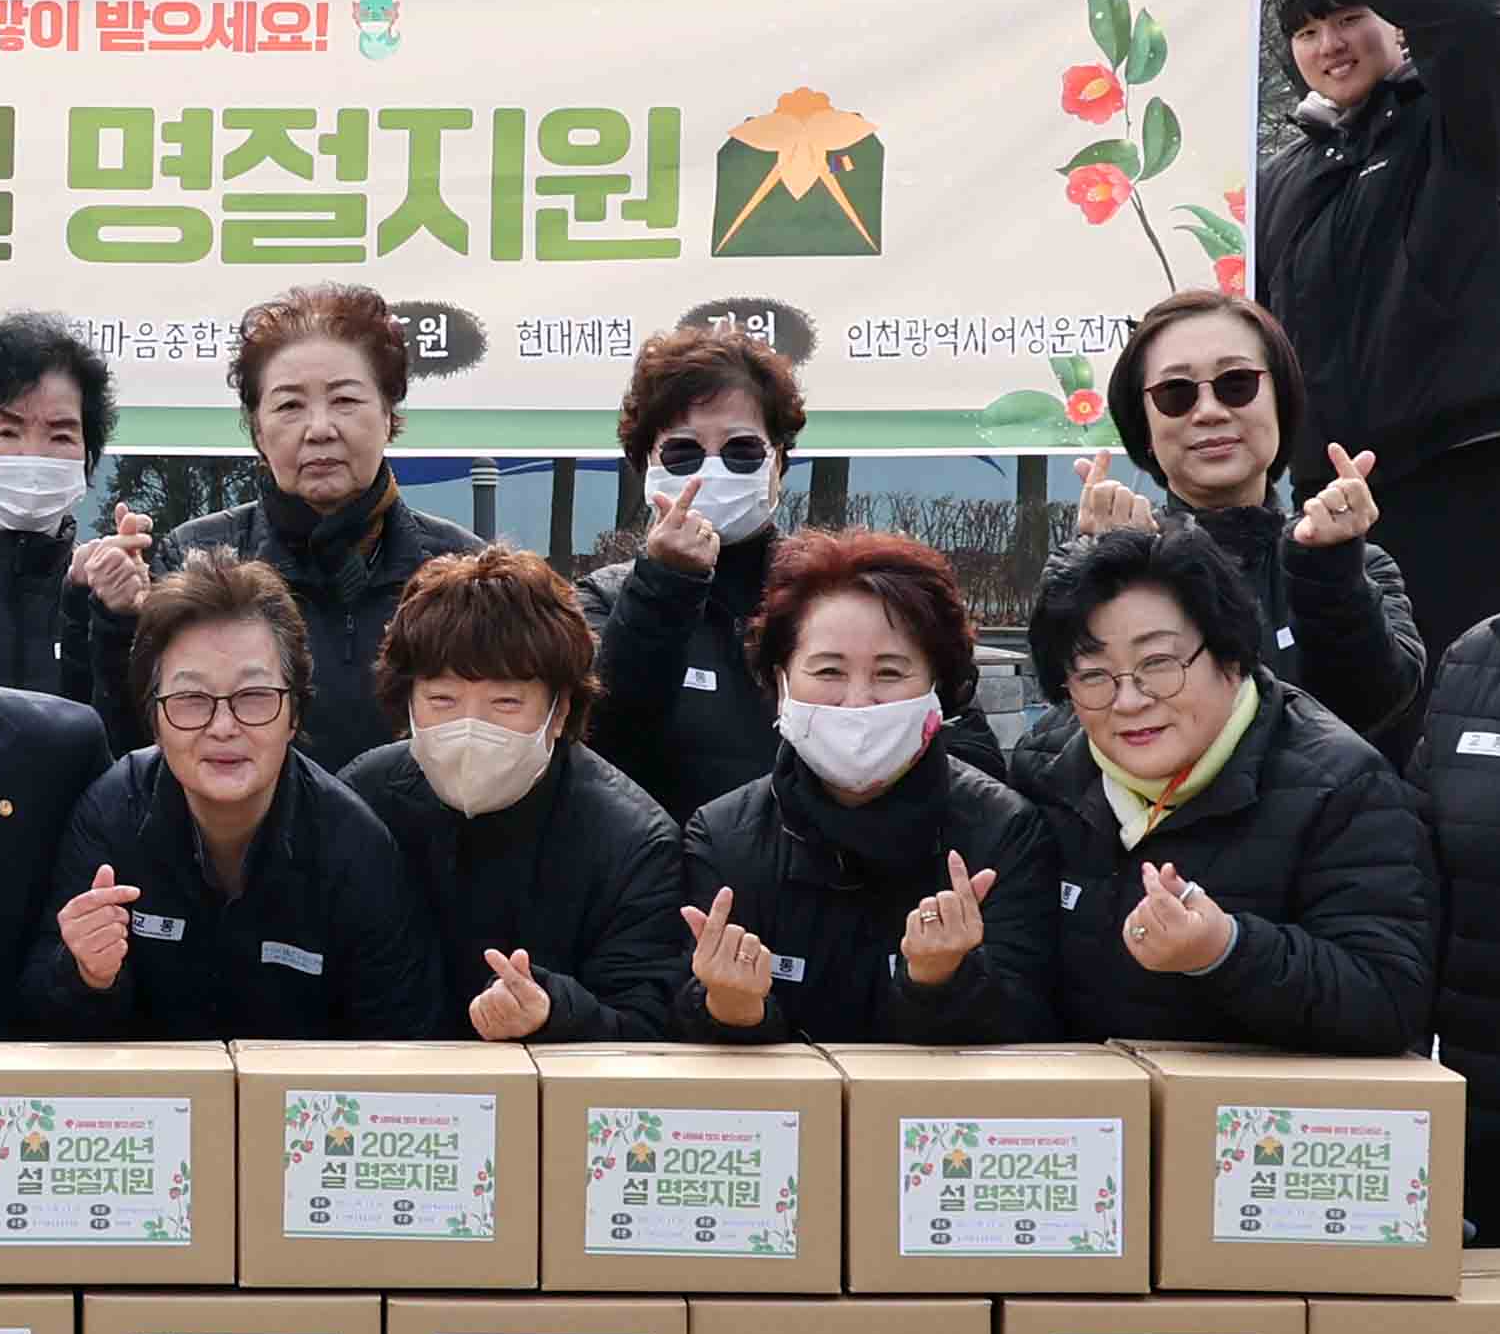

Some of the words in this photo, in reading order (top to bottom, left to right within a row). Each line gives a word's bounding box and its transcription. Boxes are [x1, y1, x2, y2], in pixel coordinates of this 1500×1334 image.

[95, 0, 328, 53] 받으세요!
[66, 106, 682, 264] 명절지원
[398, 312, 449, 358] 원
[516, 318, 633, 358] 현대제철
[57, 1136, 153, 1163] 2024년
[361, 1131, 457, 1159] 2024년
[1291, 1143, 1389, 1170] 2024년
[321, 1161, 346, 1189] 설
[355, 1162, 456, 1191] 명절지원
[663, 1147, 759, 1176] 2024년
[980, 1154, 1078, 1180] 2024년
[17, 1167, 42, 1195] 설
[51, 1168, 152, 1195] 명절지원
[622, 1178, 648, 1206] 설
[656, 1179, 758, 1208] 명절지원
[1251, 1171, 1276, 1198] 설
[1285, 1172, 1388, 1200] 명절지원
[940, 1184, 965, 1211] 설
[974, 1184, 1077, 1210] 명절지원
